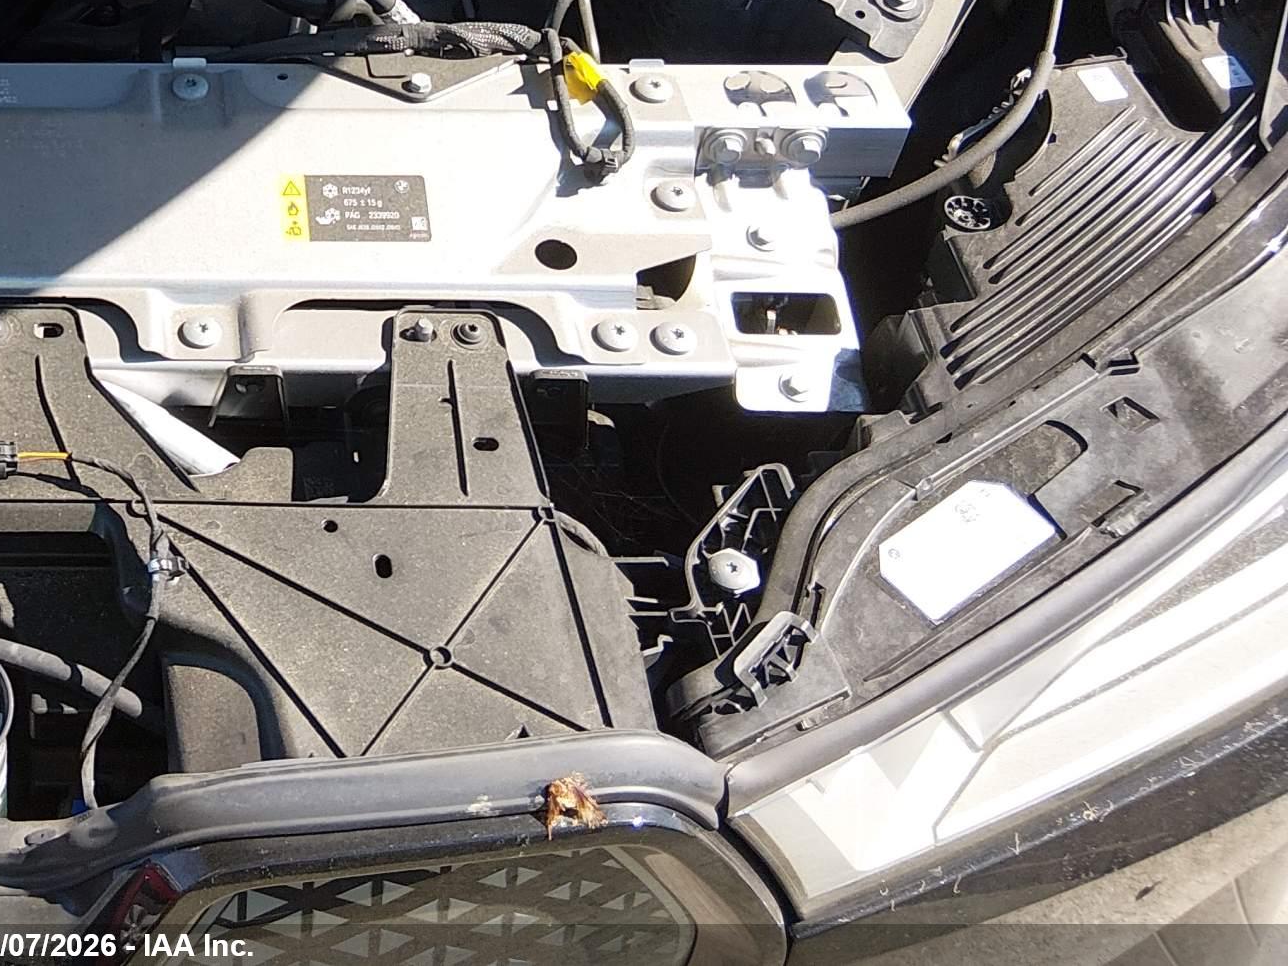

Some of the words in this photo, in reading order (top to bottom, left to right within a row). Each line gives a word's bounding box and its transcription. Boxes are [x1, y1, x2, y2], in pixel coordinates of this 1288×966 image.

[342, 186, 371, 196] R1234yf
[344, 198, 358, 206] 675
[367, 198, 376, 206] 15
